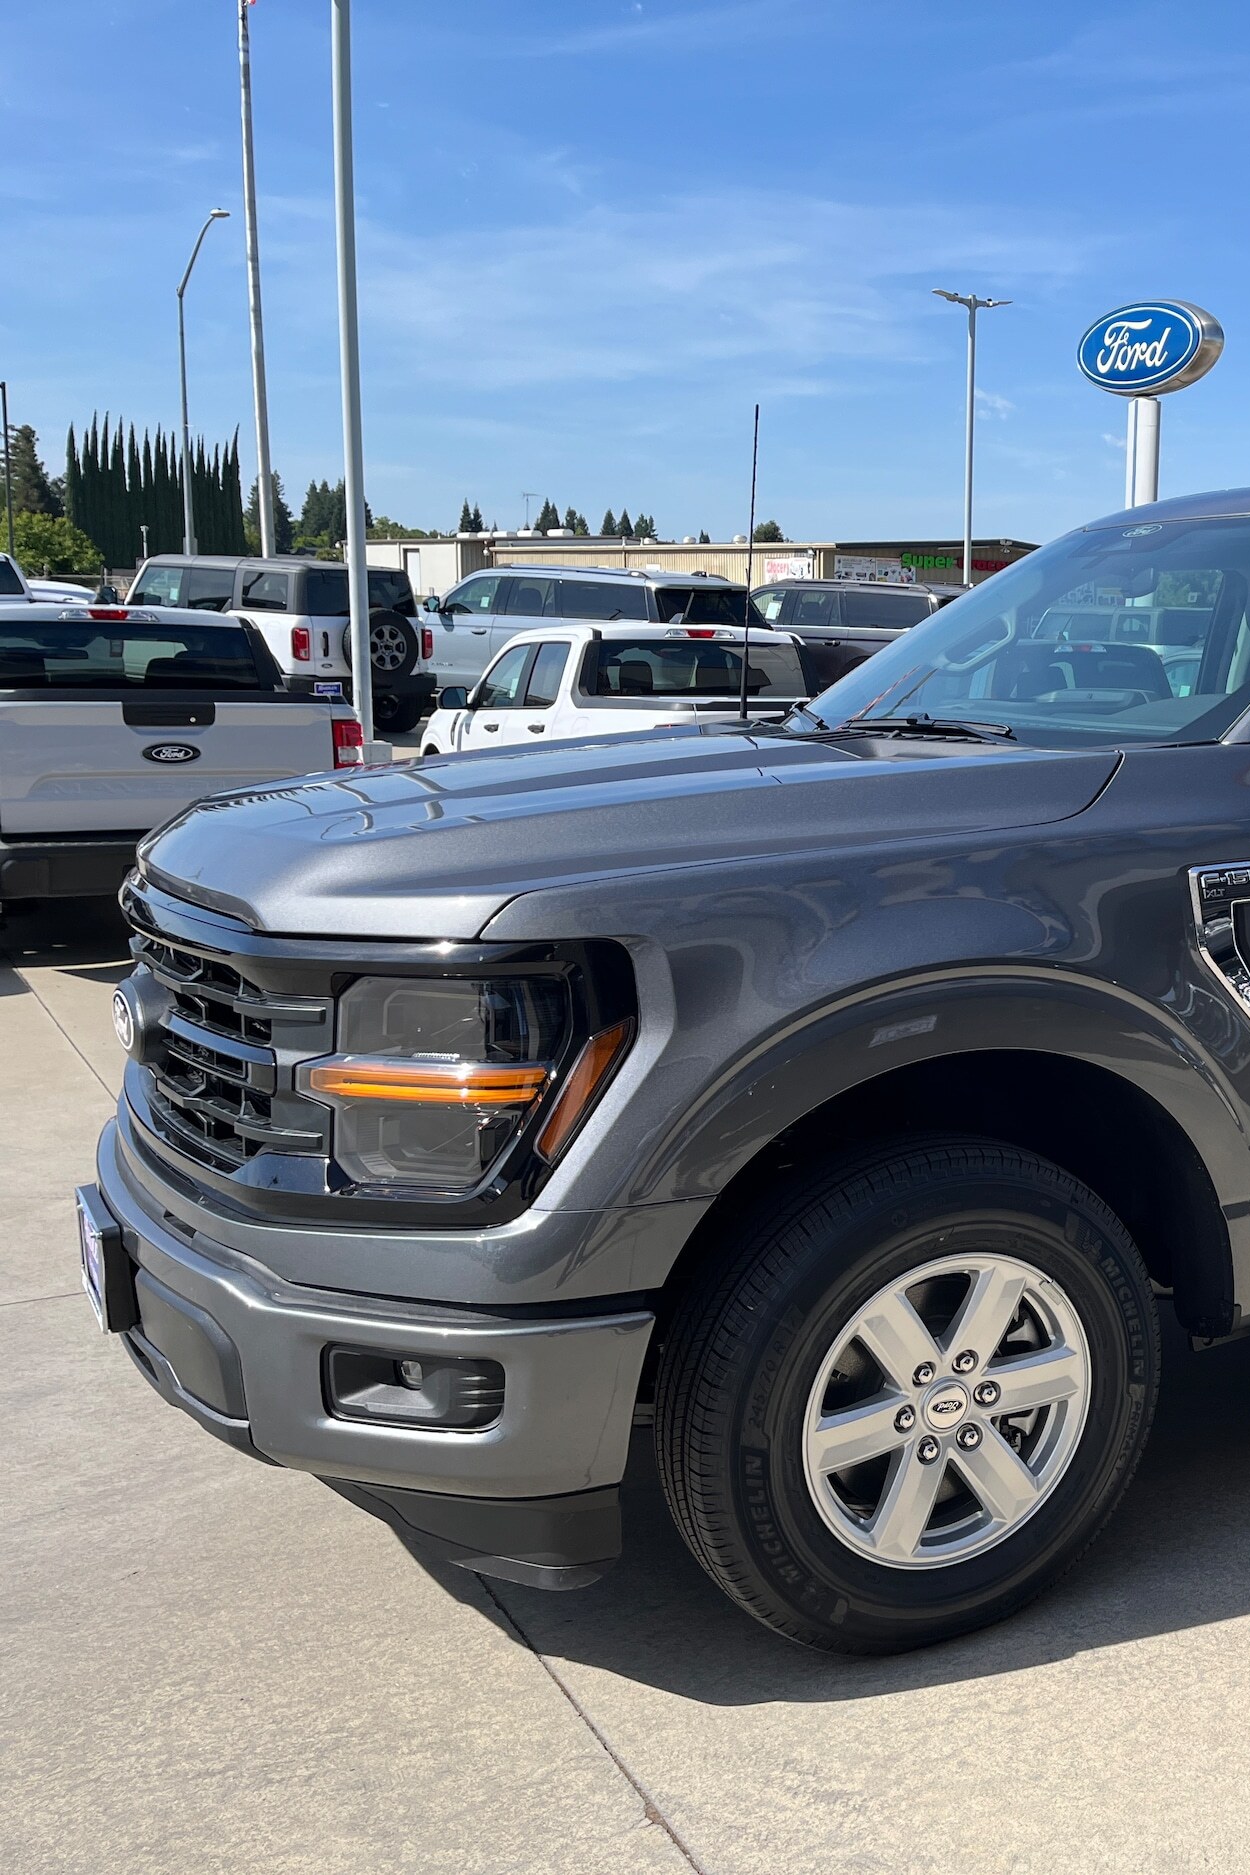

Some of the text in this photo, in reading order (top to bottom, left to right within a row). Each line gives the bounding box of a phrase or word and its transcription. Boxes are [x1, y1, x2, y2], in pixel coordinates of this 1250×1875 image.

[1097, 319, 1171, 374] Ford
[902, 552, 954, 570] Super
[160, 748, 186, 758] Ford
[1206, 888, 1226, 898] XLT
[1101, 1256, 1146, 1377] MICHELIN
[936, 1401, 959, 1413] Ford
[744, 1454, 805, 1585] MICHELIN
